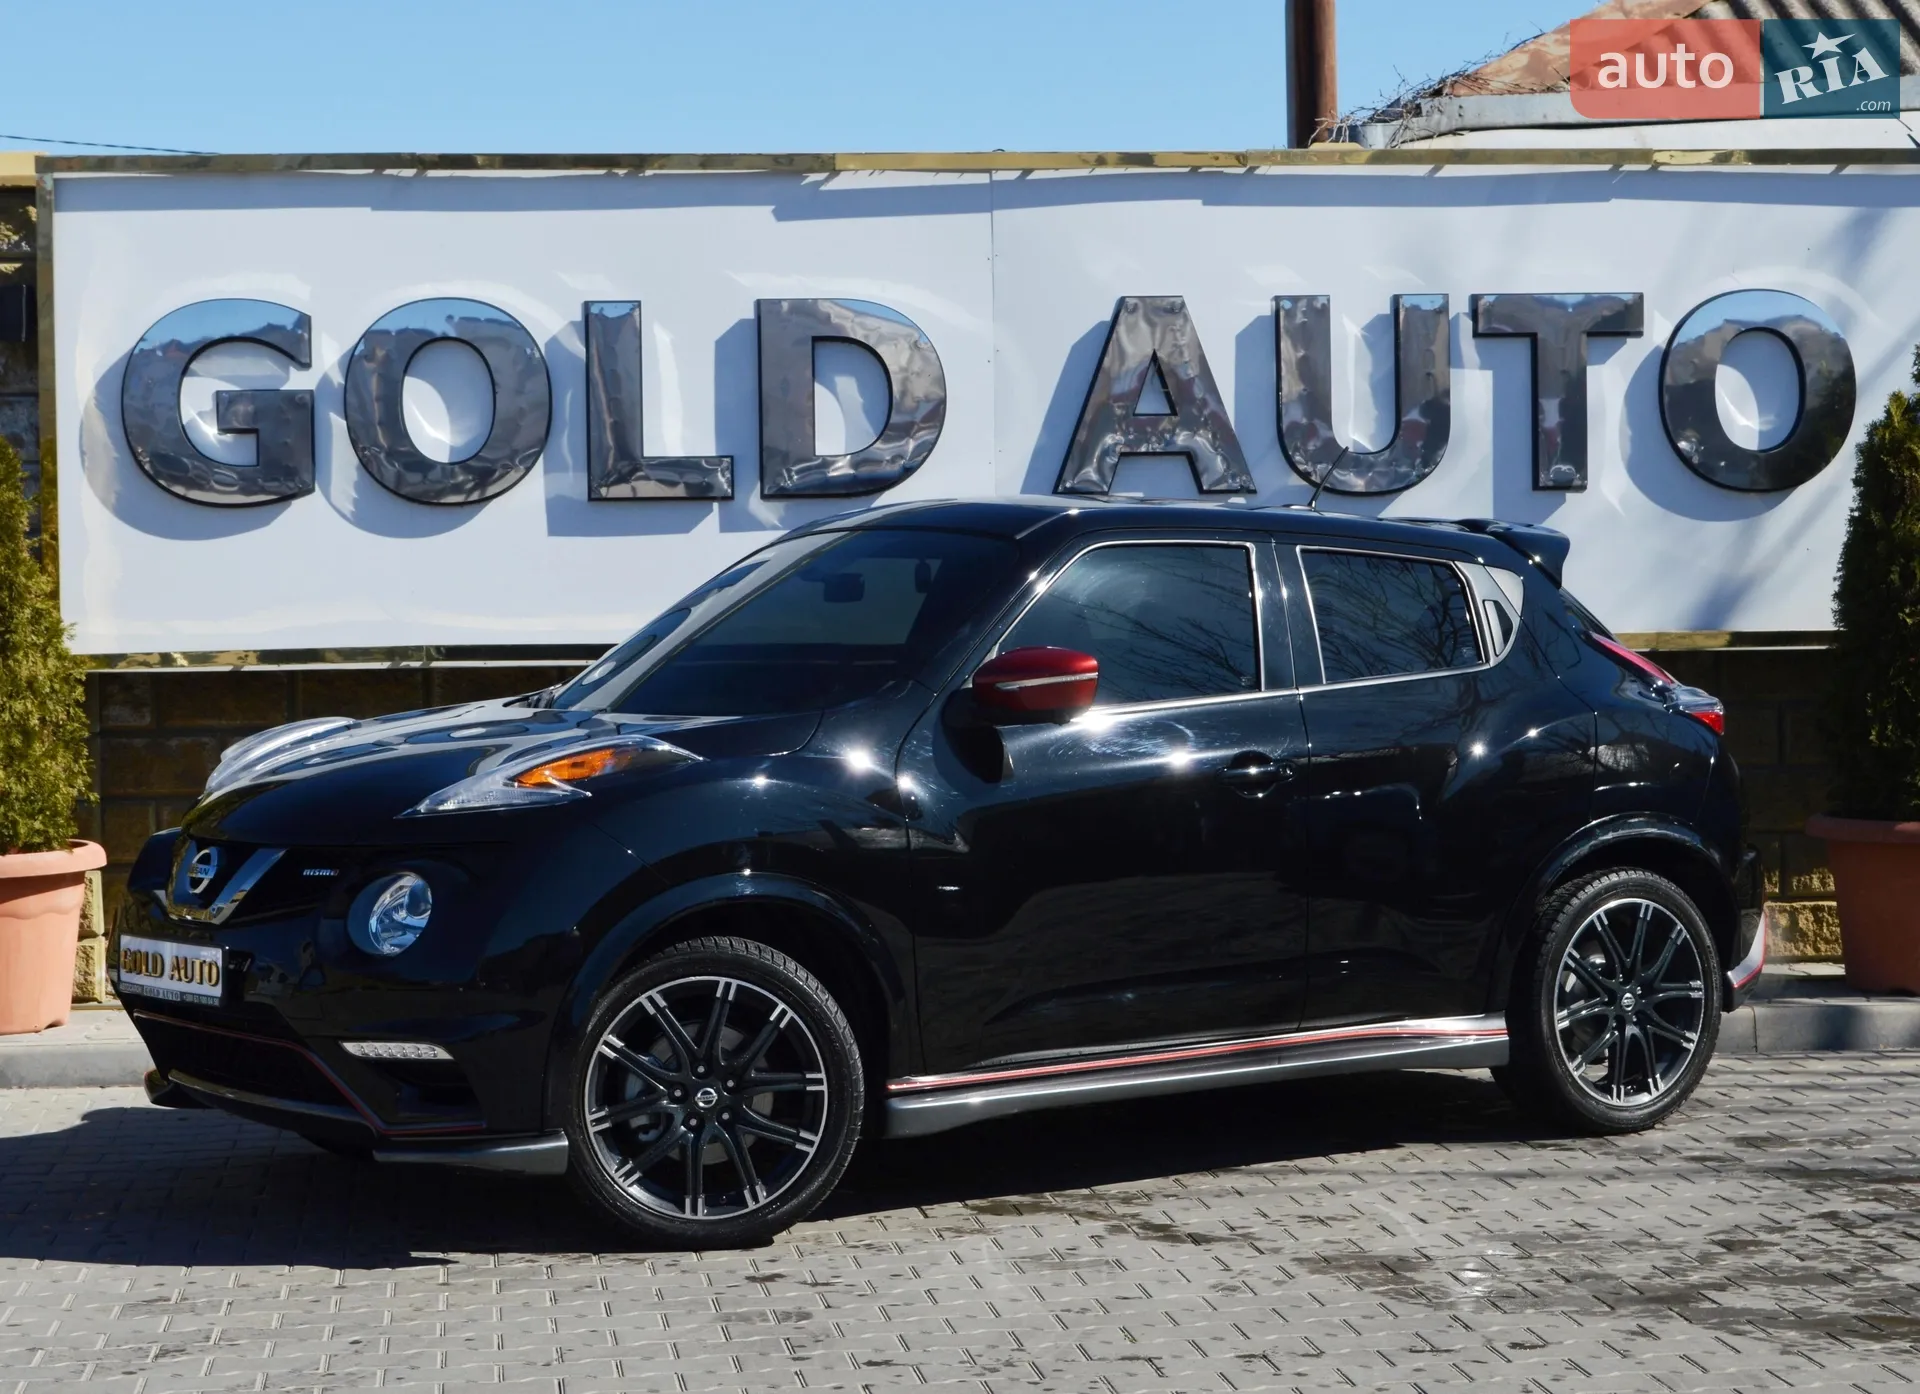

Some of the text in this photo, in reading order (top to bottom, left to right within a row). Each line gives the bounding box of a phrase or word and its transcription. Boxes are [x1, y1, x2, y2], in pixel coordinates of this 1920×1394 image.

[121, 289, 1857, 508] GOLD AUTO
[121, 947, 220, 987] GOLD AUTO
[144, 986, 160, 997] GOLD
[162, 988, 180, 1000] AUTO
